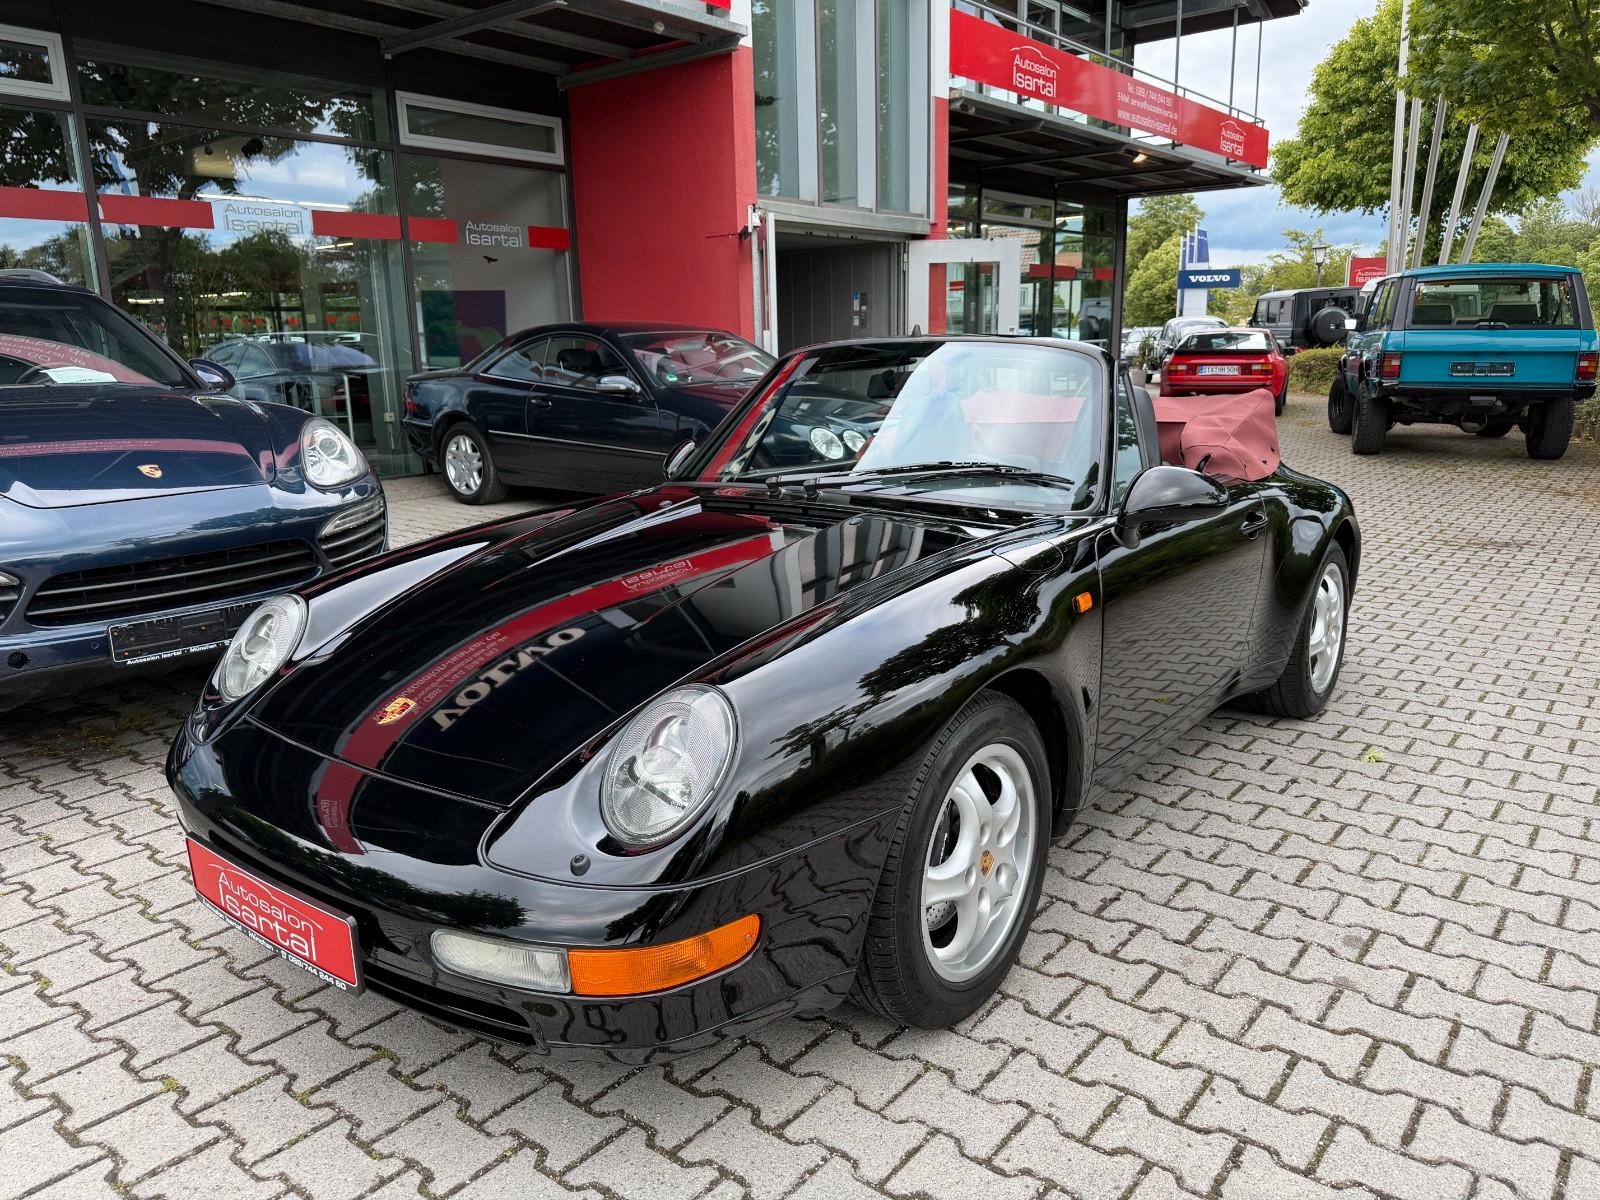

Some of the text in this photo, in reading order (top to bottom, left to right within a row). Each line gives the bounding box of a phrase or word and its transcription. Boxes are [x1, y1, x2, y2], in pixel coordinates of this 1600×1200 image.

[1013, 53, 1057, 79] Autosalon
[1012, 65, 1057, 99] Isartal
[1220, 126, 1245, 142] Autosalon
[1220, 134, 1244, 157] Isartal
[224, 202, 303, 219] Autosalon
[222, 213, 304, 235] Isartal
[465, 220, 522, 234] Autosalon
[465, 229, 523, 248] Isartal
[1188, 274, 1231, 283] VOLVO
[218, 871, 315, 936] Autosalon
[218, 882, 317, 962] Isartal
